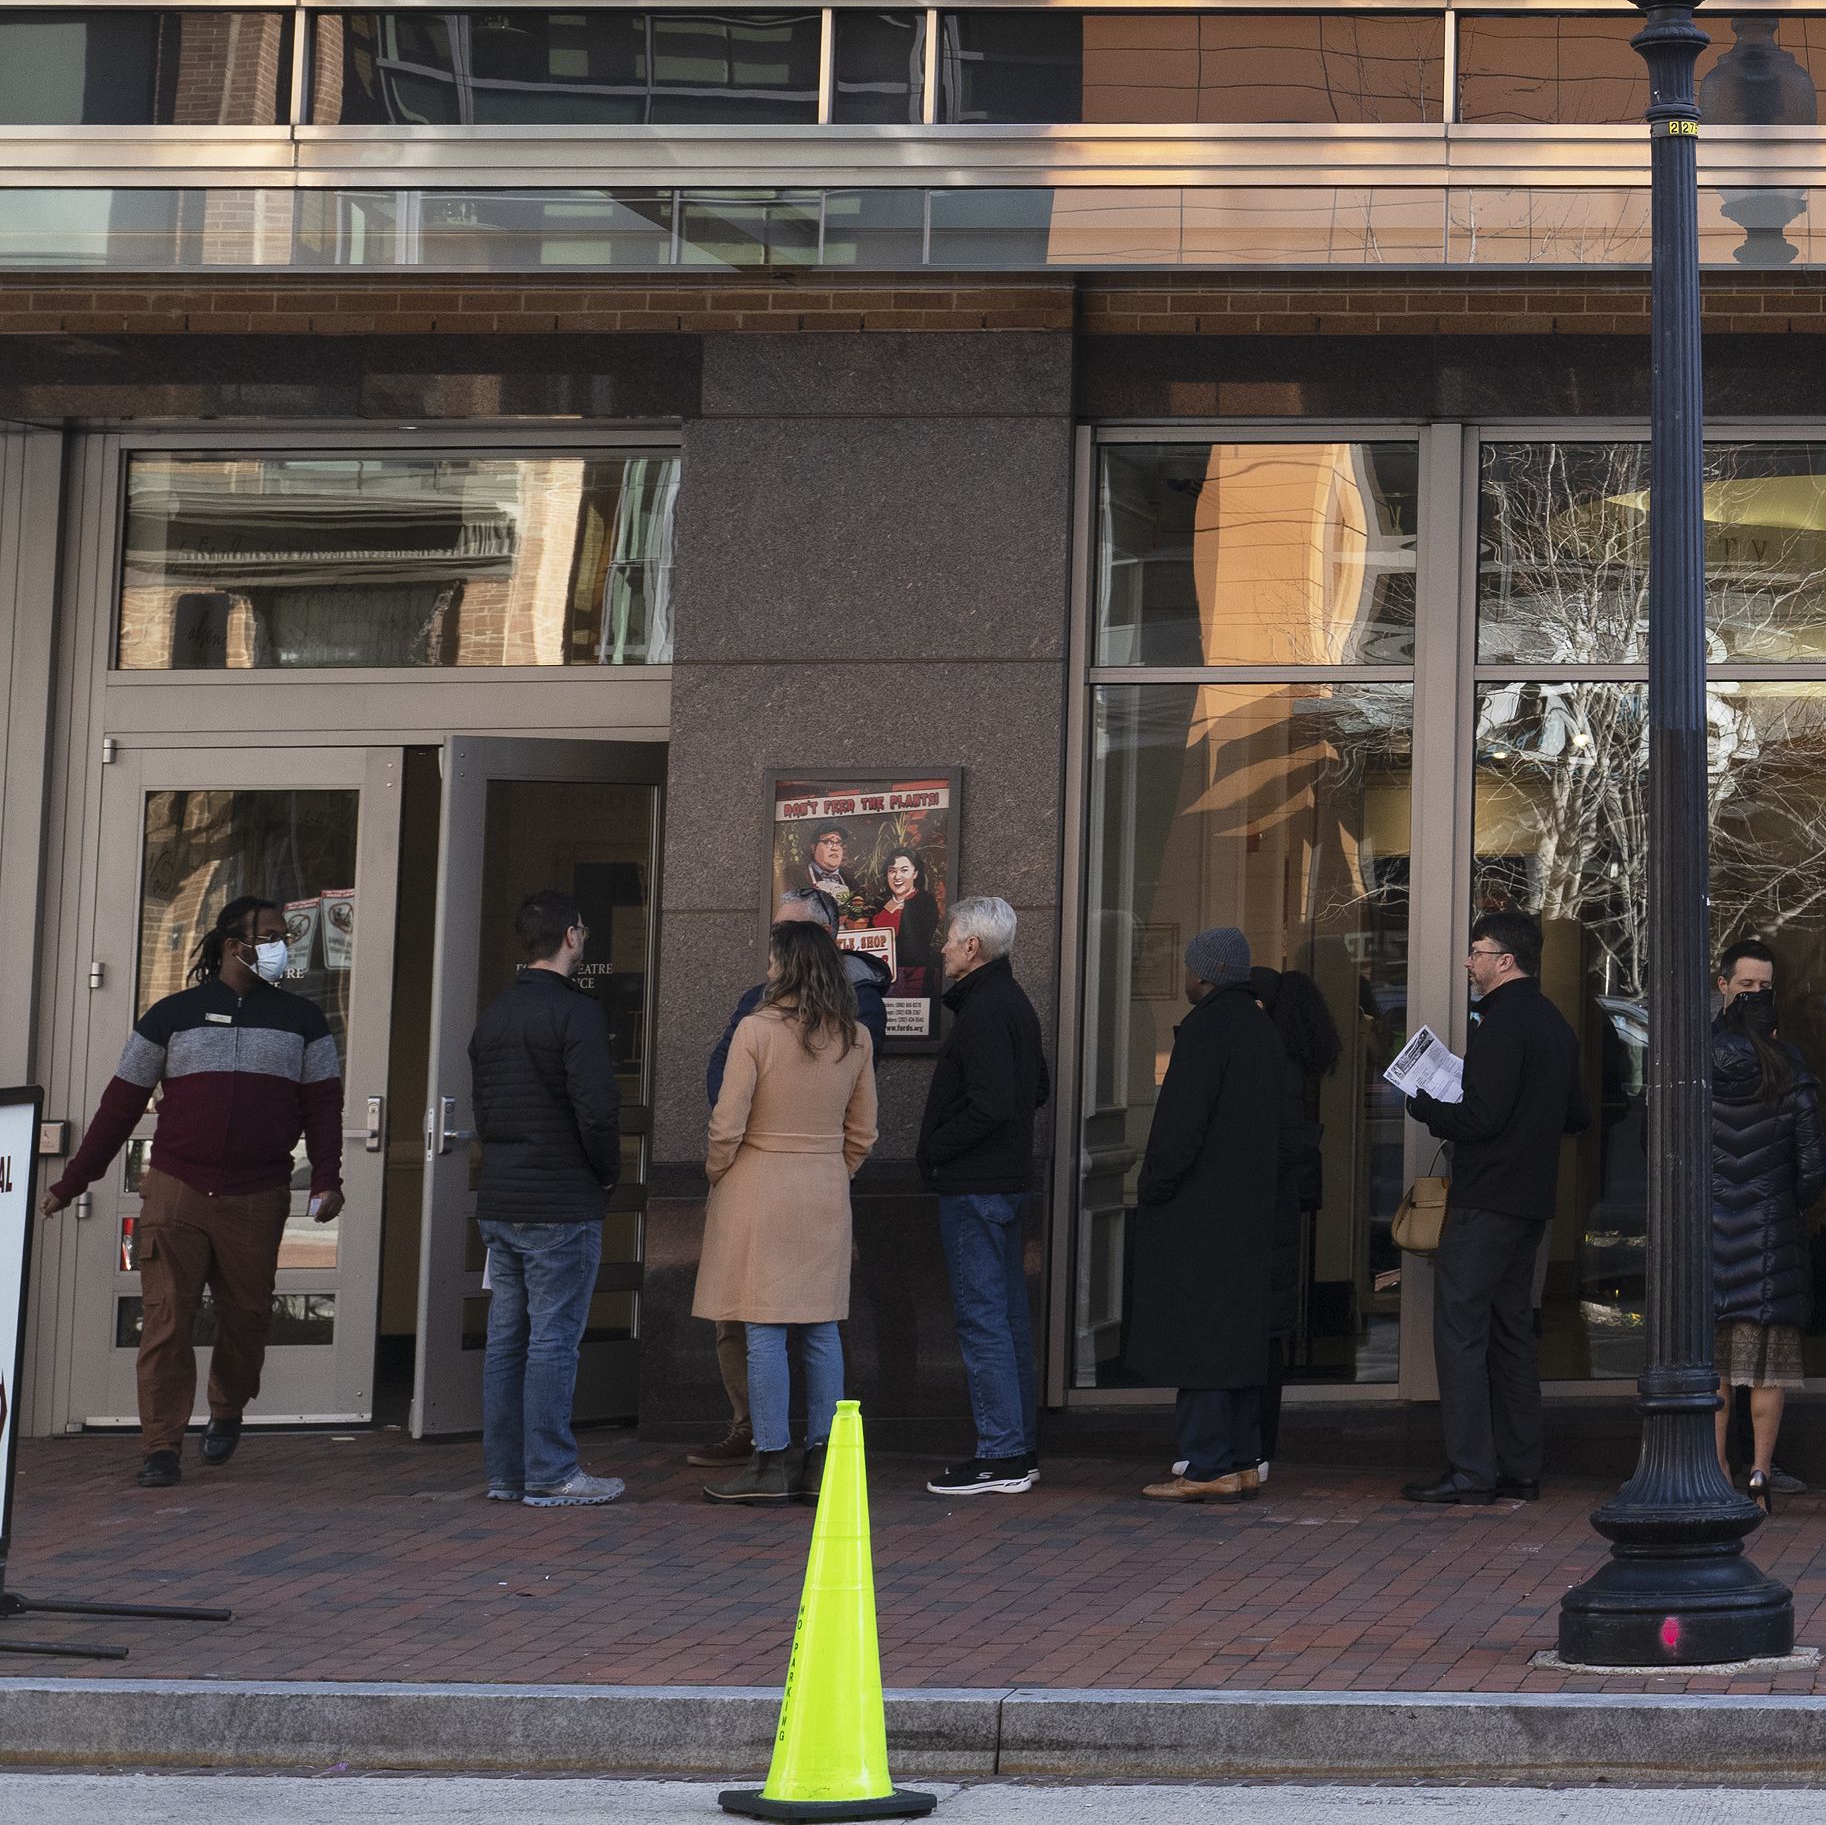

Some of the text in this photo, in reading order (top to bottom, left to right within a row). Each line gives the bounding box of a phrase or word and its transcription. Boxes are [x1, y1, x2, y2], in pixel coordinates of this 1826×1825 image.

[784, 792, 940, 818] DON'T FEED THE PLANTS!
[861, 935, 887, 950] SHOP
[779, 1604, 805, 1742] NO PARKING
